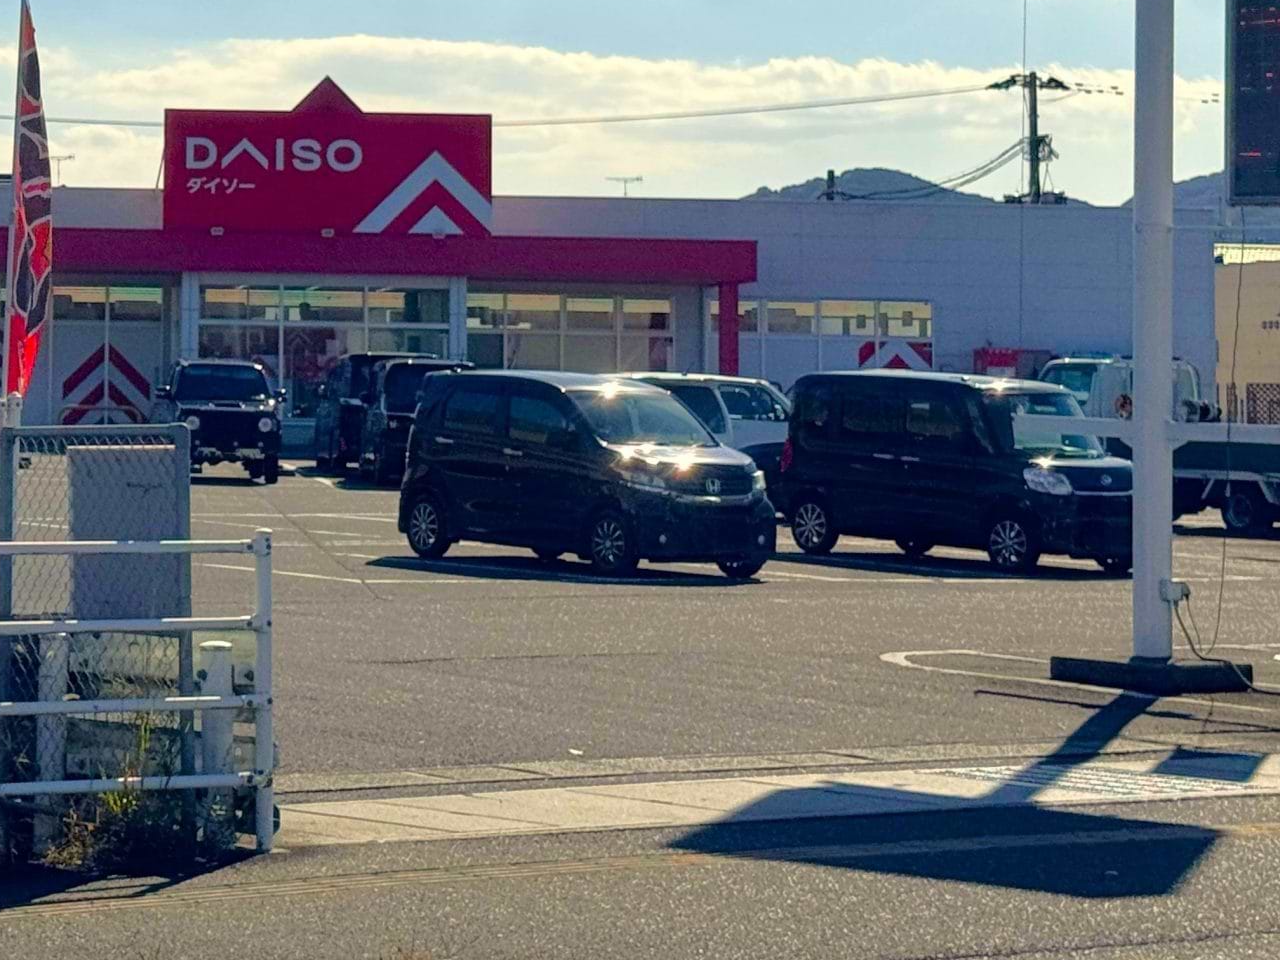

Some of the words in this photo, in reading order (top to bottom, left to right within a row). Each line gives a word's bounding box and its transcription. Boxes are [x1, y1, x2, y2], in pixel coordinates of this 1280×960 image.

[185, 136, 363, 172] DAISO
[186, 176, 256, 194] ダイソー
